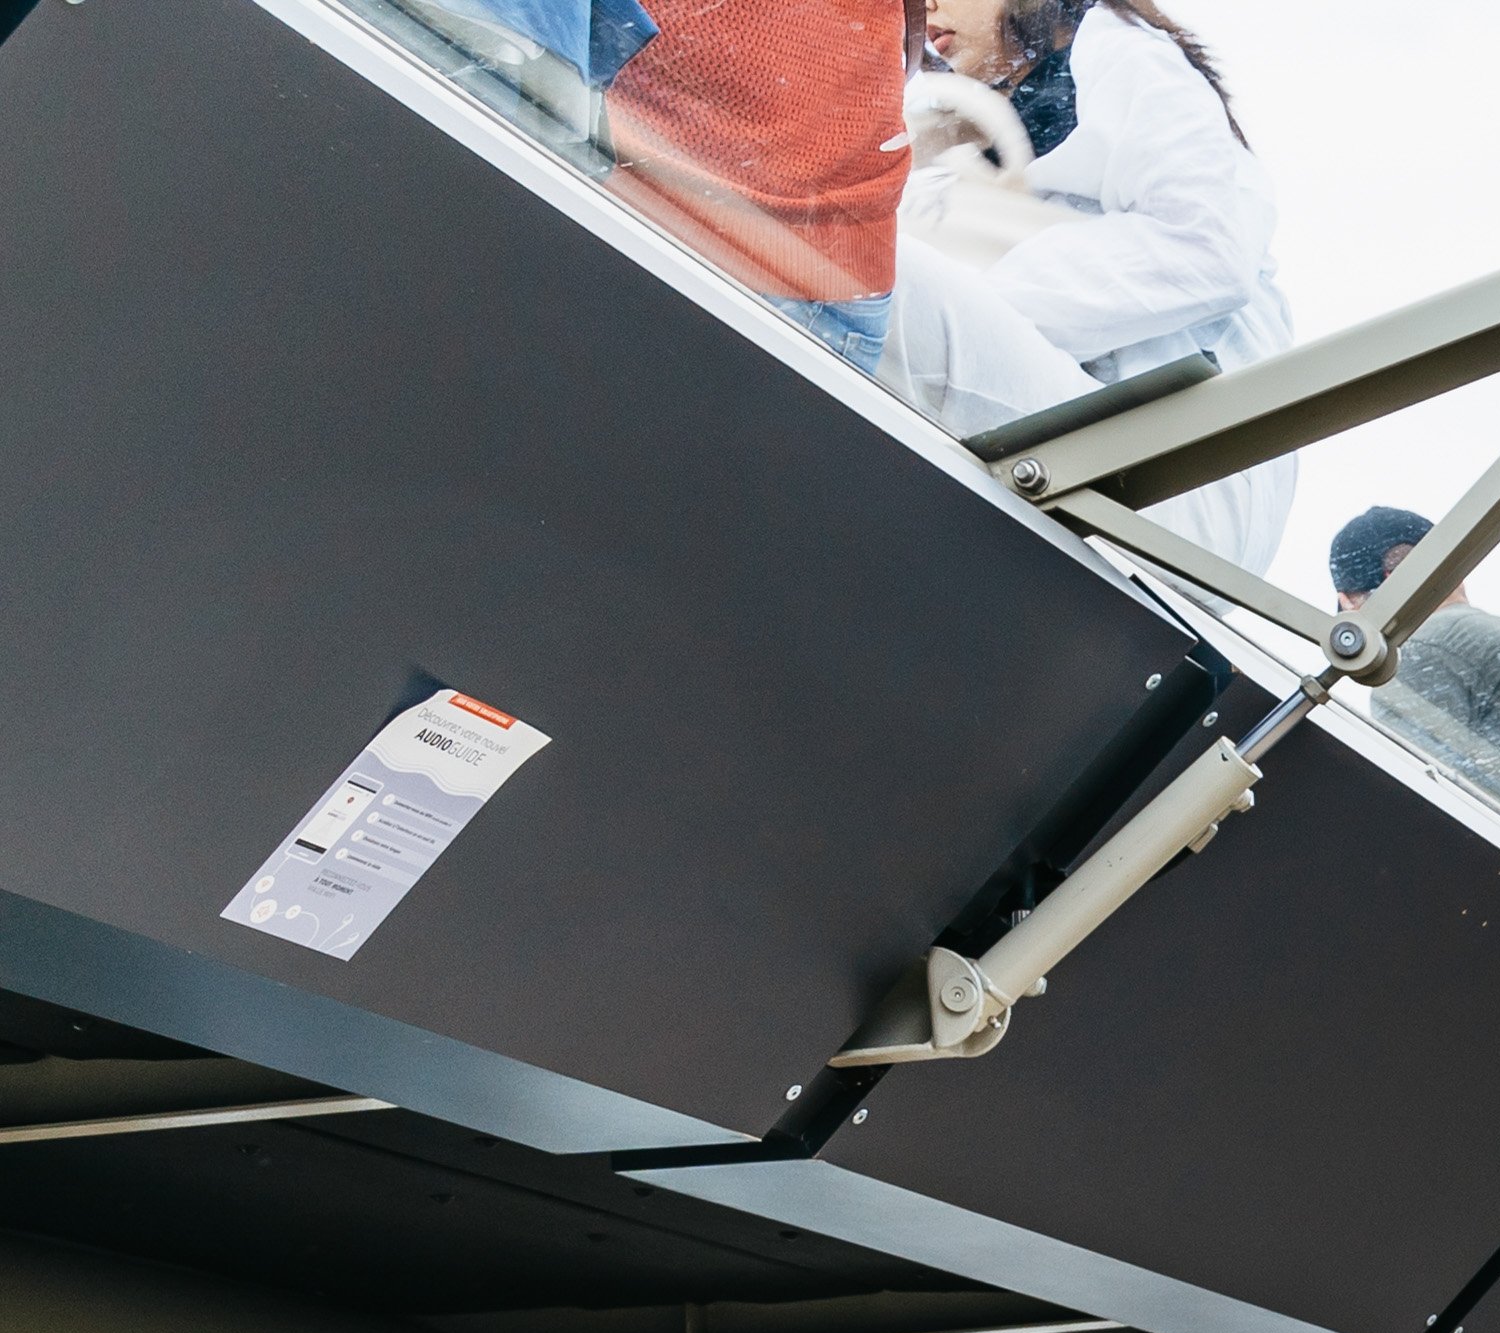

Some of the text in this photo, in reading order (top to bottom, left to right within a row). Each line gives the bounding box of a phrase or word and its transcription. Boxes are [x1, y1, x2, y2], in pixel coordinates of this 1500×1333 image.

[414, 728, 487, 767] AUDIOGUIDE
[417, 707, 511, 755] Découvrez votre nouvel
